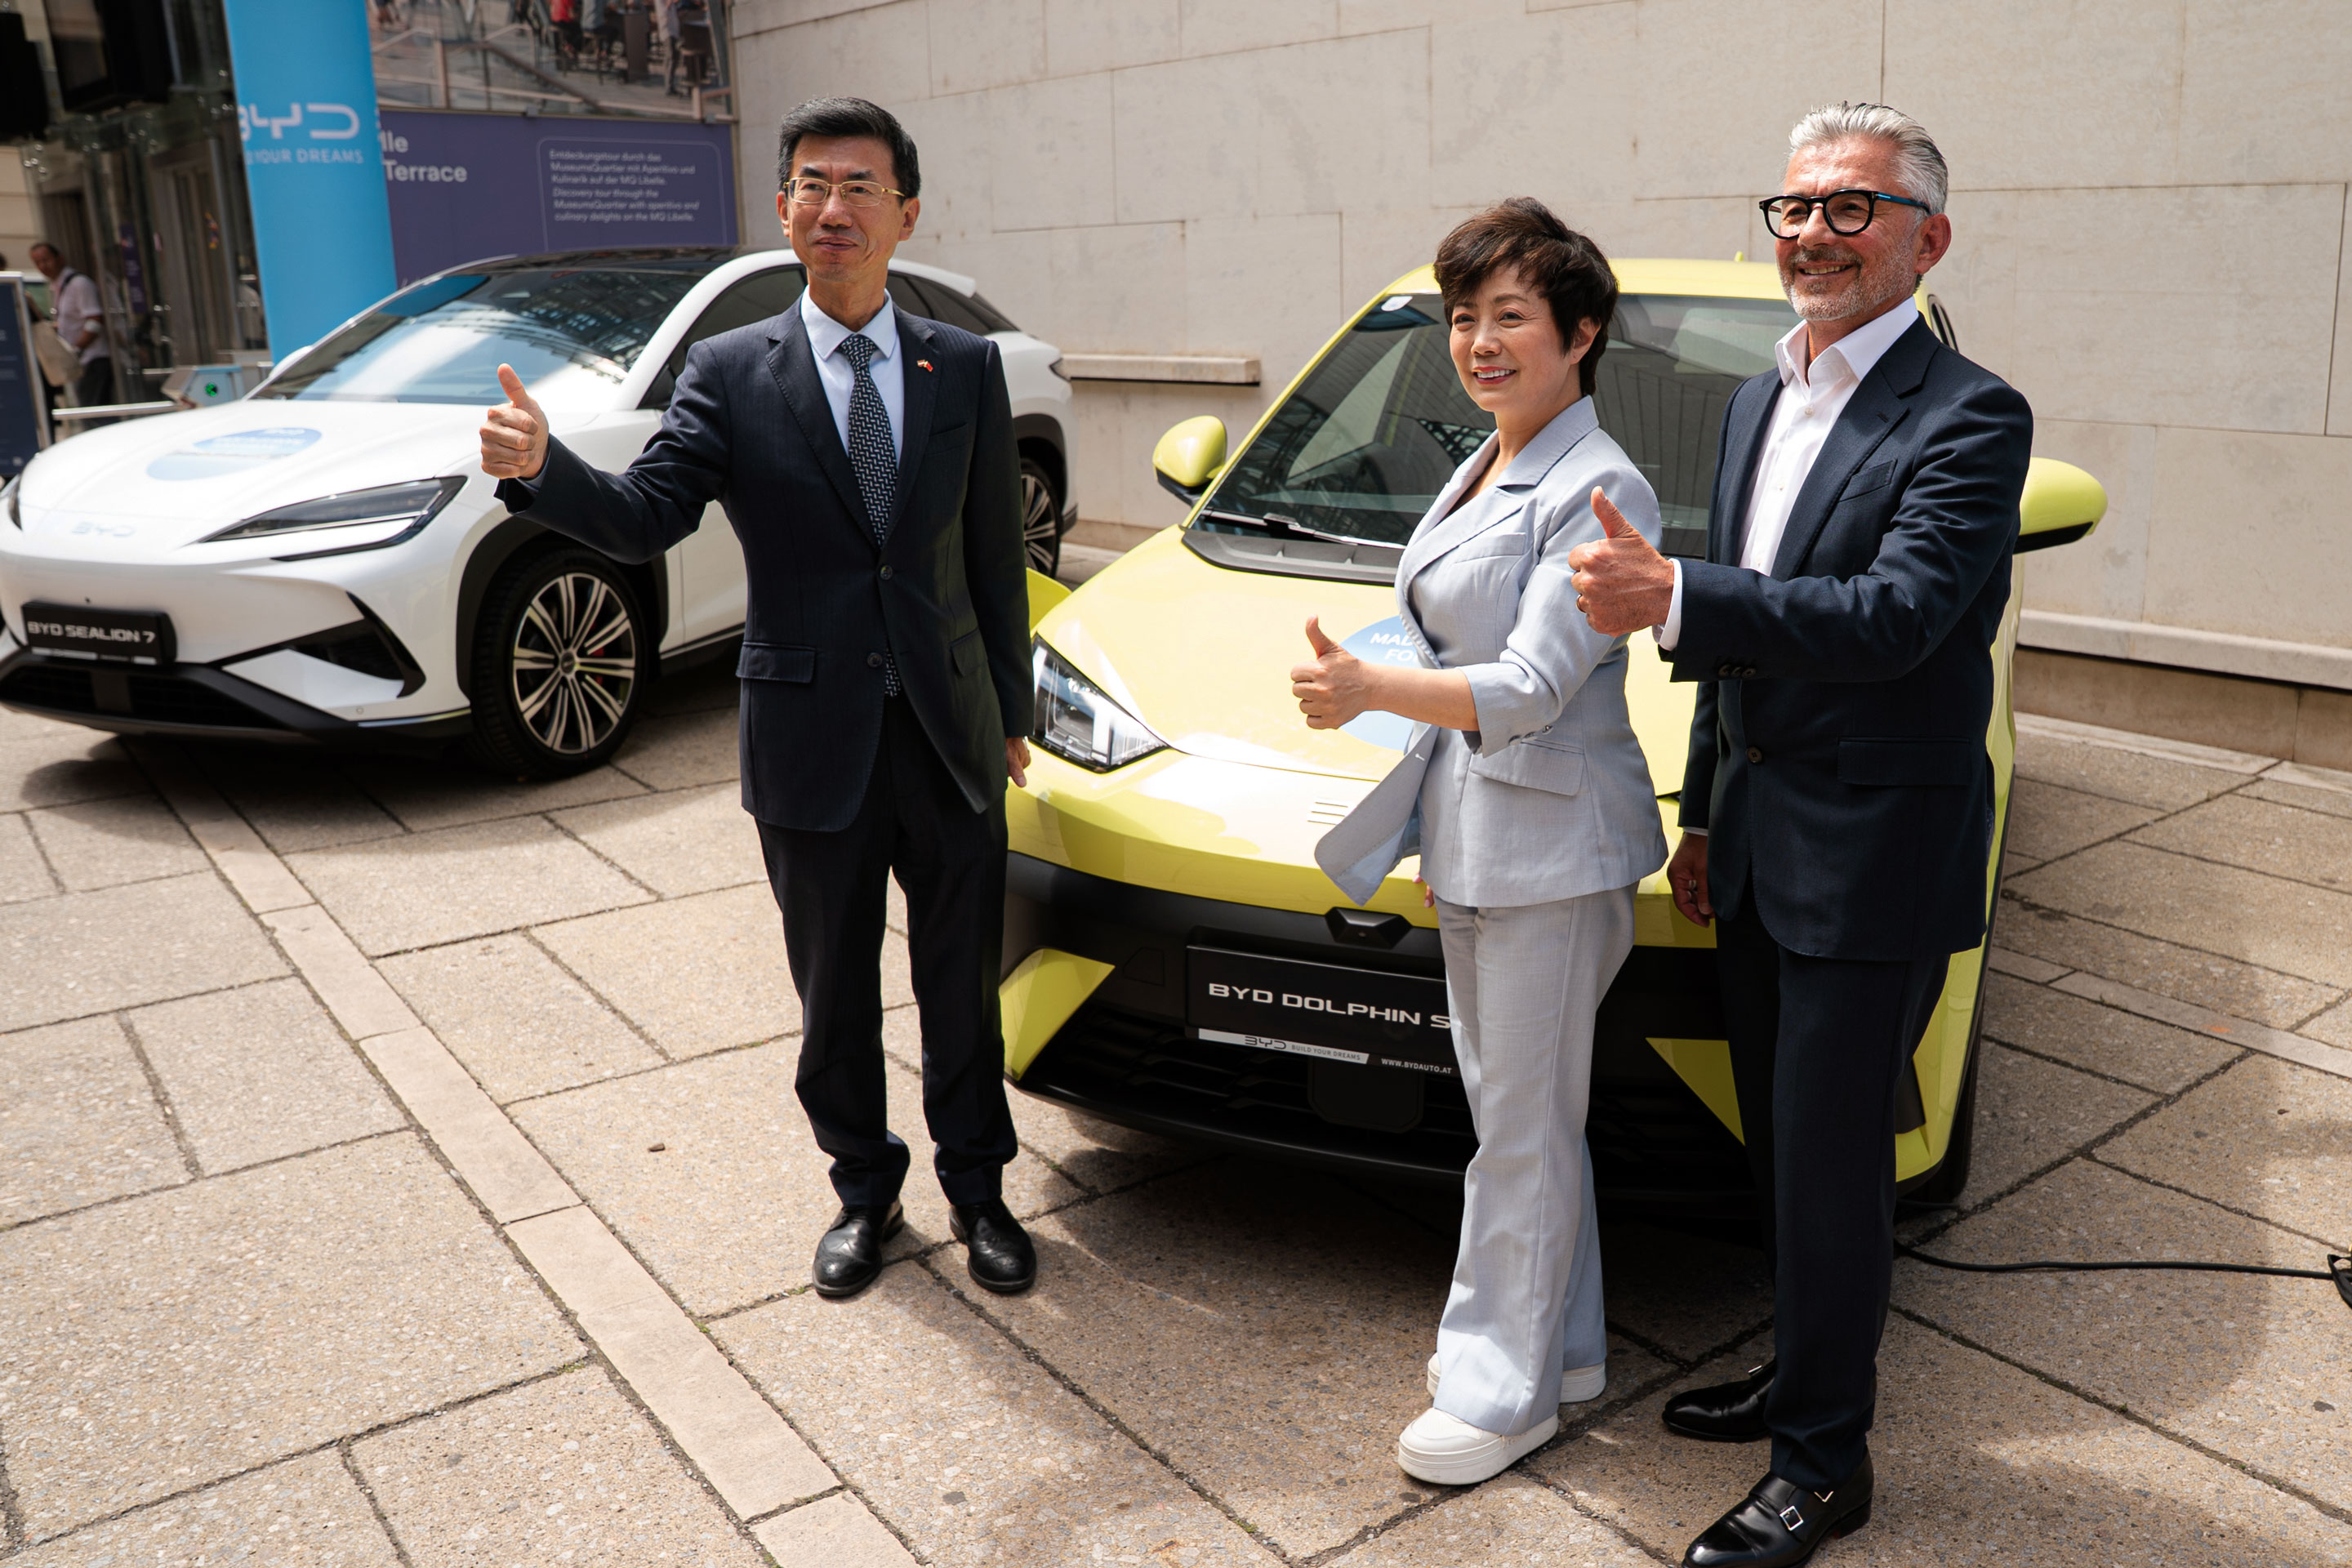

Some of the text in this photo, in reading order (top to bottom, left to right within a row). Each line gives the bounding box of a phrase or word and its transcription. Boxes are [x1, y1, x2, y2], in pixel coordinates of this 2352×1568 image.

[380, 131, 408, 153] lle
[296, 149, 363, 164] DREAMS
[383, 160, 468, 182] Terrace
[28, 621, 156, 644] BYD SEALION 7
[1385, 649, 1418, 662] FO
[1209, 982, 1273, 1004] BYD
[1282, 993, 1420, 1025] DOLPHIN
[1245, 1036, 1452, 1075] BYD BUILD YOUR DREAMS WWW.BYDAUTO.AT
